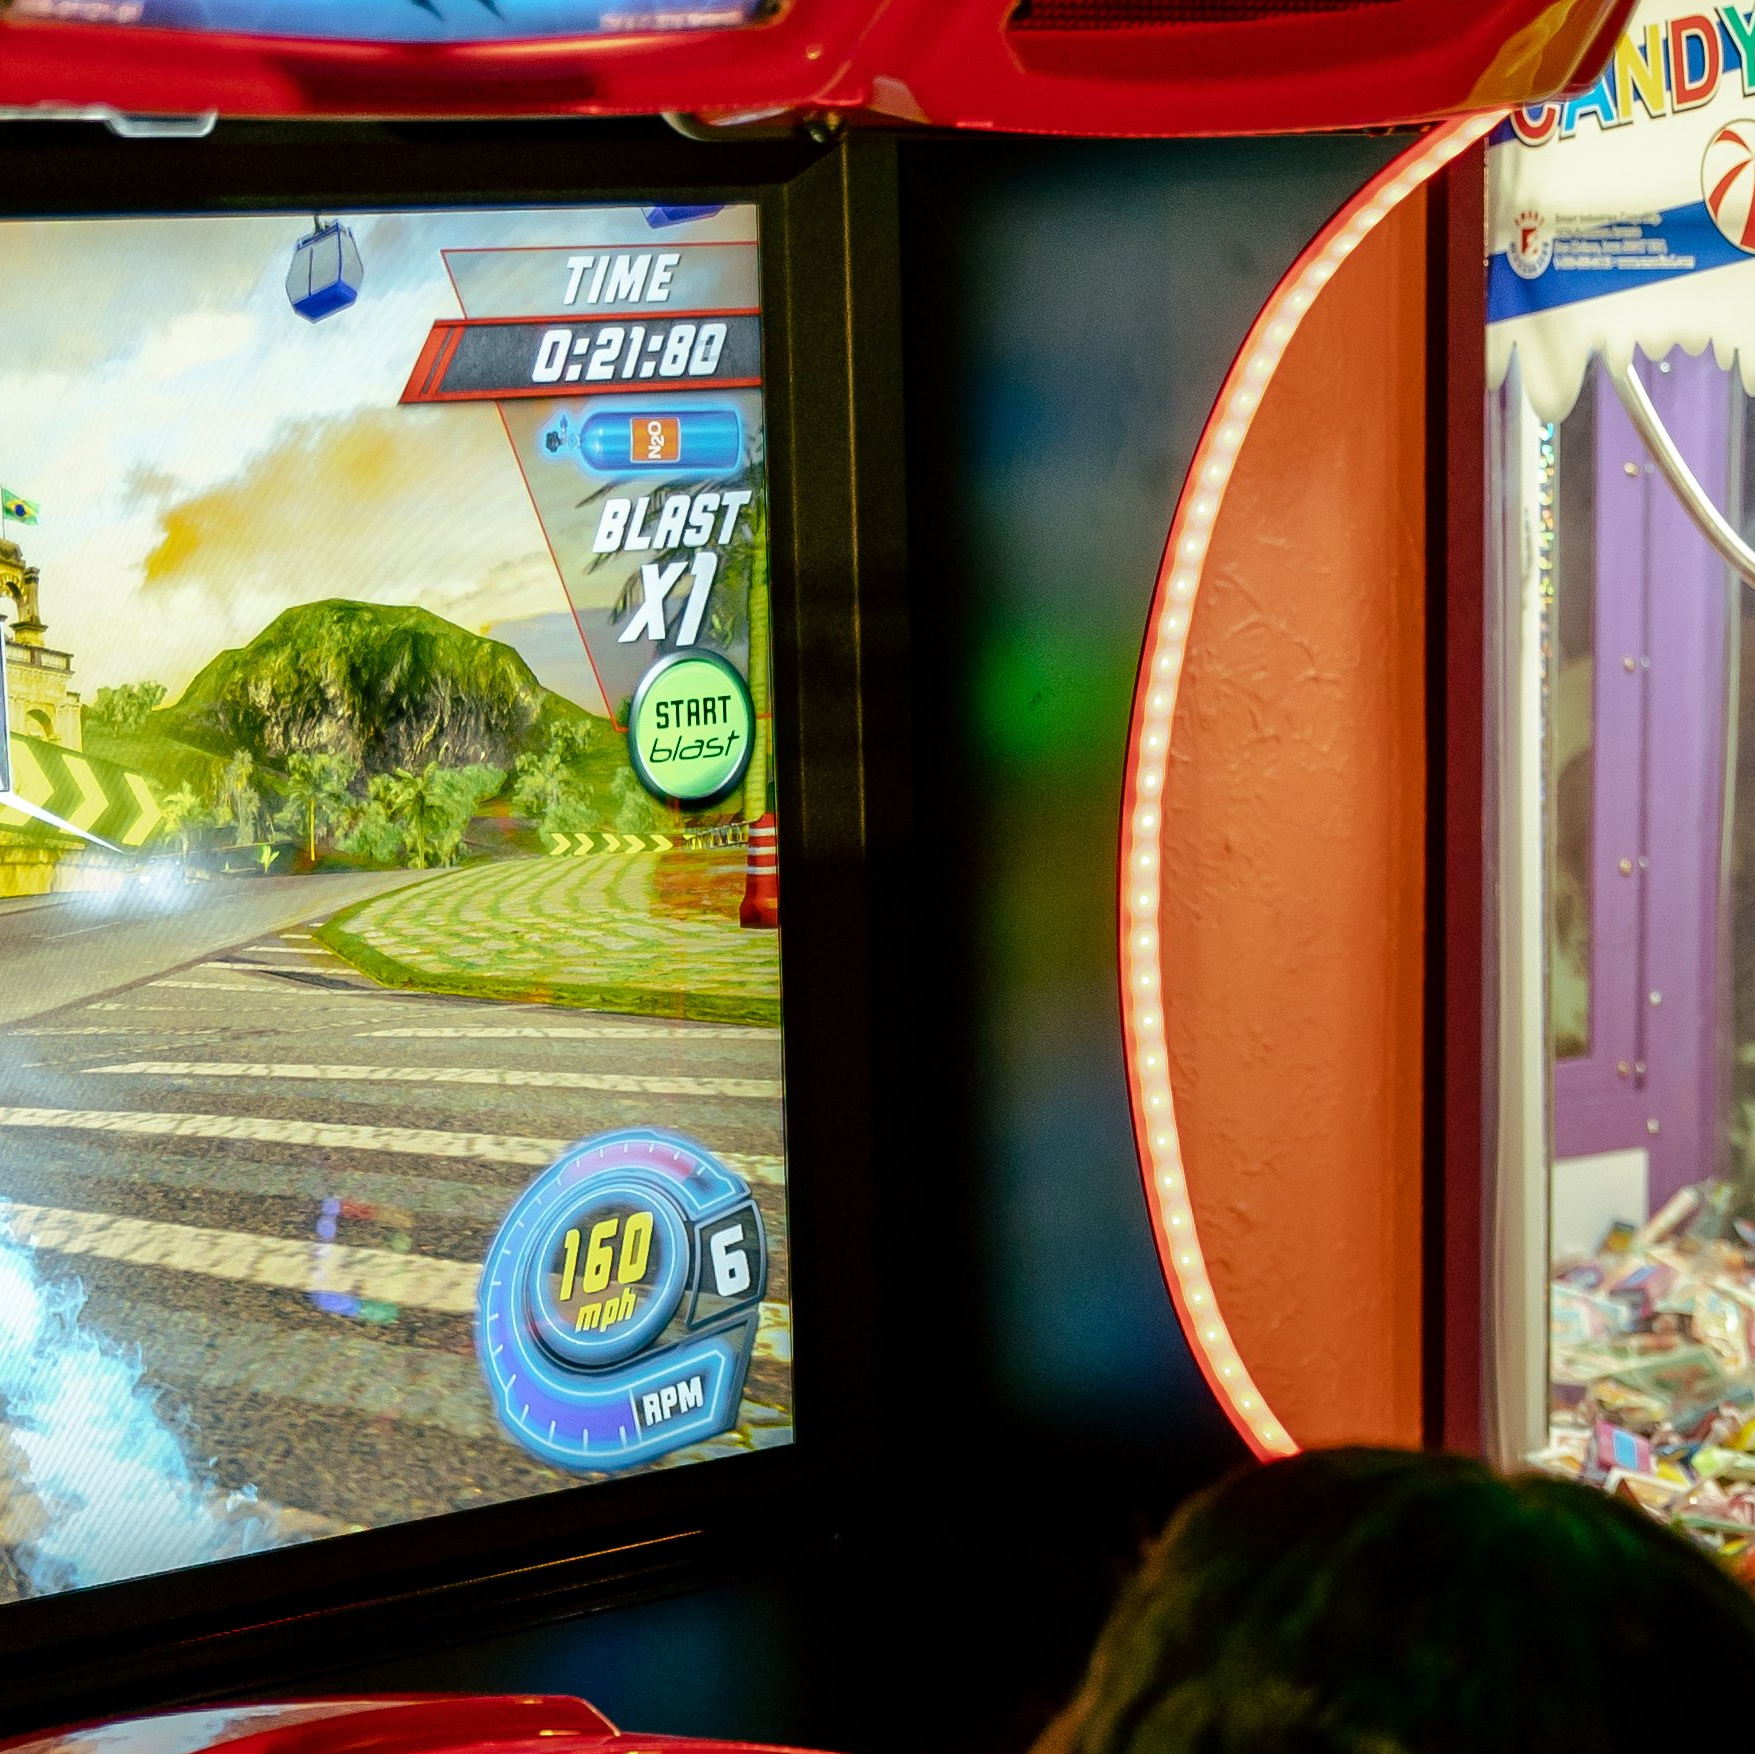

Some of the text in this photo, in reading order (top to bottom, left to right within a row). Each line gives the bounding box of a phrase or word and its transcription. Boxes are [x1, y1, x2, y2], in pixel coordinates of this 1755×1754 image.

[562, 253, 680, 306] TIME
[592, 490, 752, 553] BLAST
[618, 551, 718, 647] X1
[656, 696, 732, 730] START
[649, 729, 741, 764] blast
[559, 1211, 654, 1301] 160
[710, 1223, 751, 1297] 6
[575, 1288, 637, 1333] mph
[642, 1375, 704, 1426] RPM
